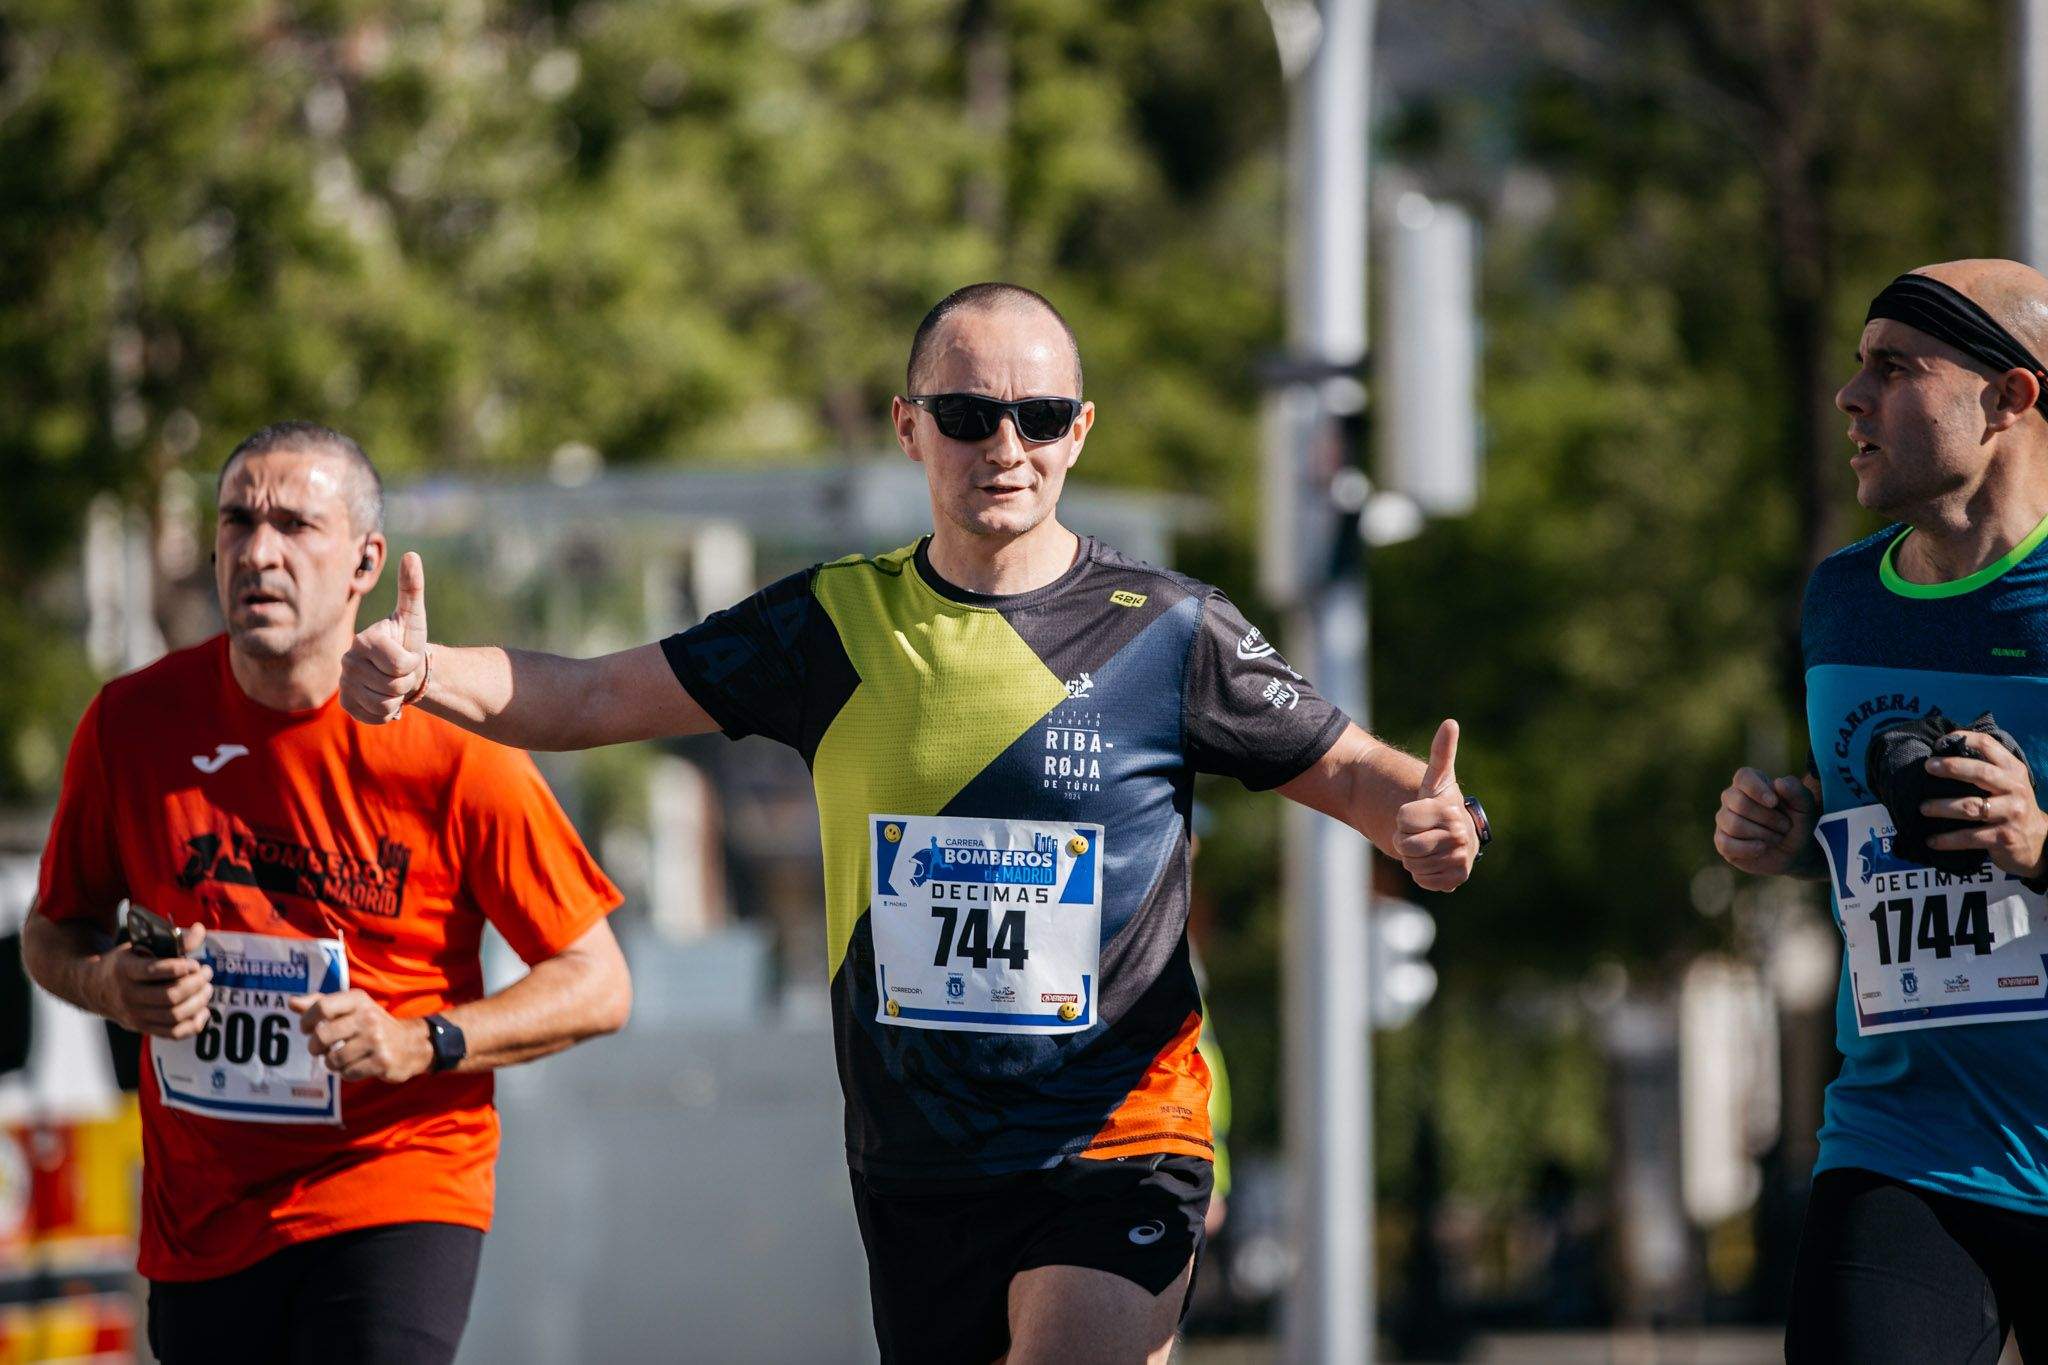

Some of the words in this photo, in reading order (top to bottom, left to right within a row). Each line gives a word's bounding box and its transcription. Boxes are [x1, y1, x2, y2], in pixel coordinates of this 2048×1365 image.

[1262, 677, 1282, 701] SOM
[1272, 689, 1291, 709] RIU
[1835, 693, 1920, 759] CARRERA
[1046, 730, 1113, 753] RIBA-
[1044, 779, 1058, 788] DE
[1066, 780, 1100, 792] TÚRIA
[945, 838, 985, 847] CARRERA
[944, 848, 1053, 868] BOMBEROS
[1003, 866, 1053, 884] MADRID
[931, 883, 1049, 904] DECIMAS
[931, 906, 1029, 970] 744
[1869, 890, 1995, 966] 1744
[195, 1007, 291, 1066] 606
